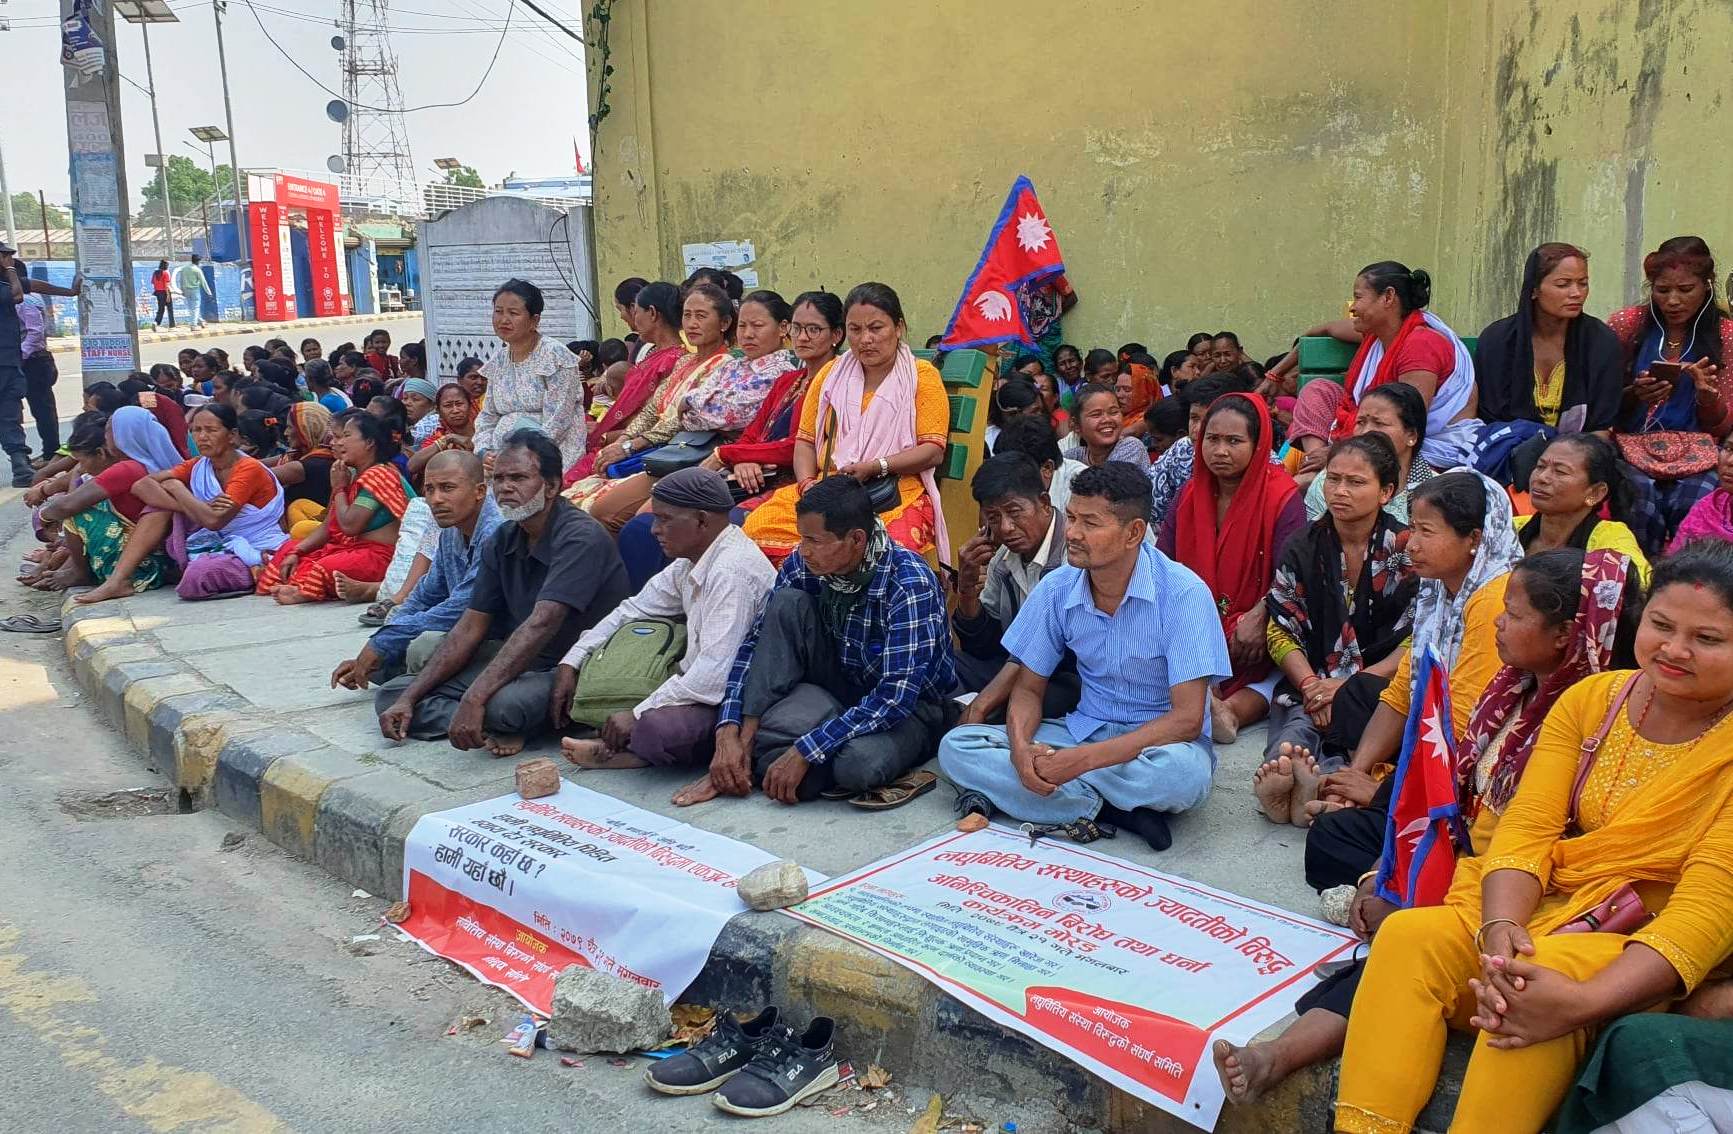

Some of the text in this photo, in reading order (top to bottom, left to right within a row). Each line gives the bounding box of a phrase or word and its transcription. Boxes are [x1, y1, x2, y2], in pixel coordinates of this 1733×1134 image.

[259, 207, 272, 277] WELCOME TO
[316, 215, 330, 279] WELCOME TO
[448, 825, 495, 853] सरकार
[520, 838, 571, 858] सरकार
[434, 844, 464, 869] हामी
[962, 900, 1045, 929] कार्यक्रम
[1050, 943, 1073, 956] गते
[1114, 936, 1162, 956] तथा
[1160, 952, 1213, 973] धर्ना
[1092, 1006, 1132, 1030] आयोजक
[1153, 1055, 1184, 1079] समिति
